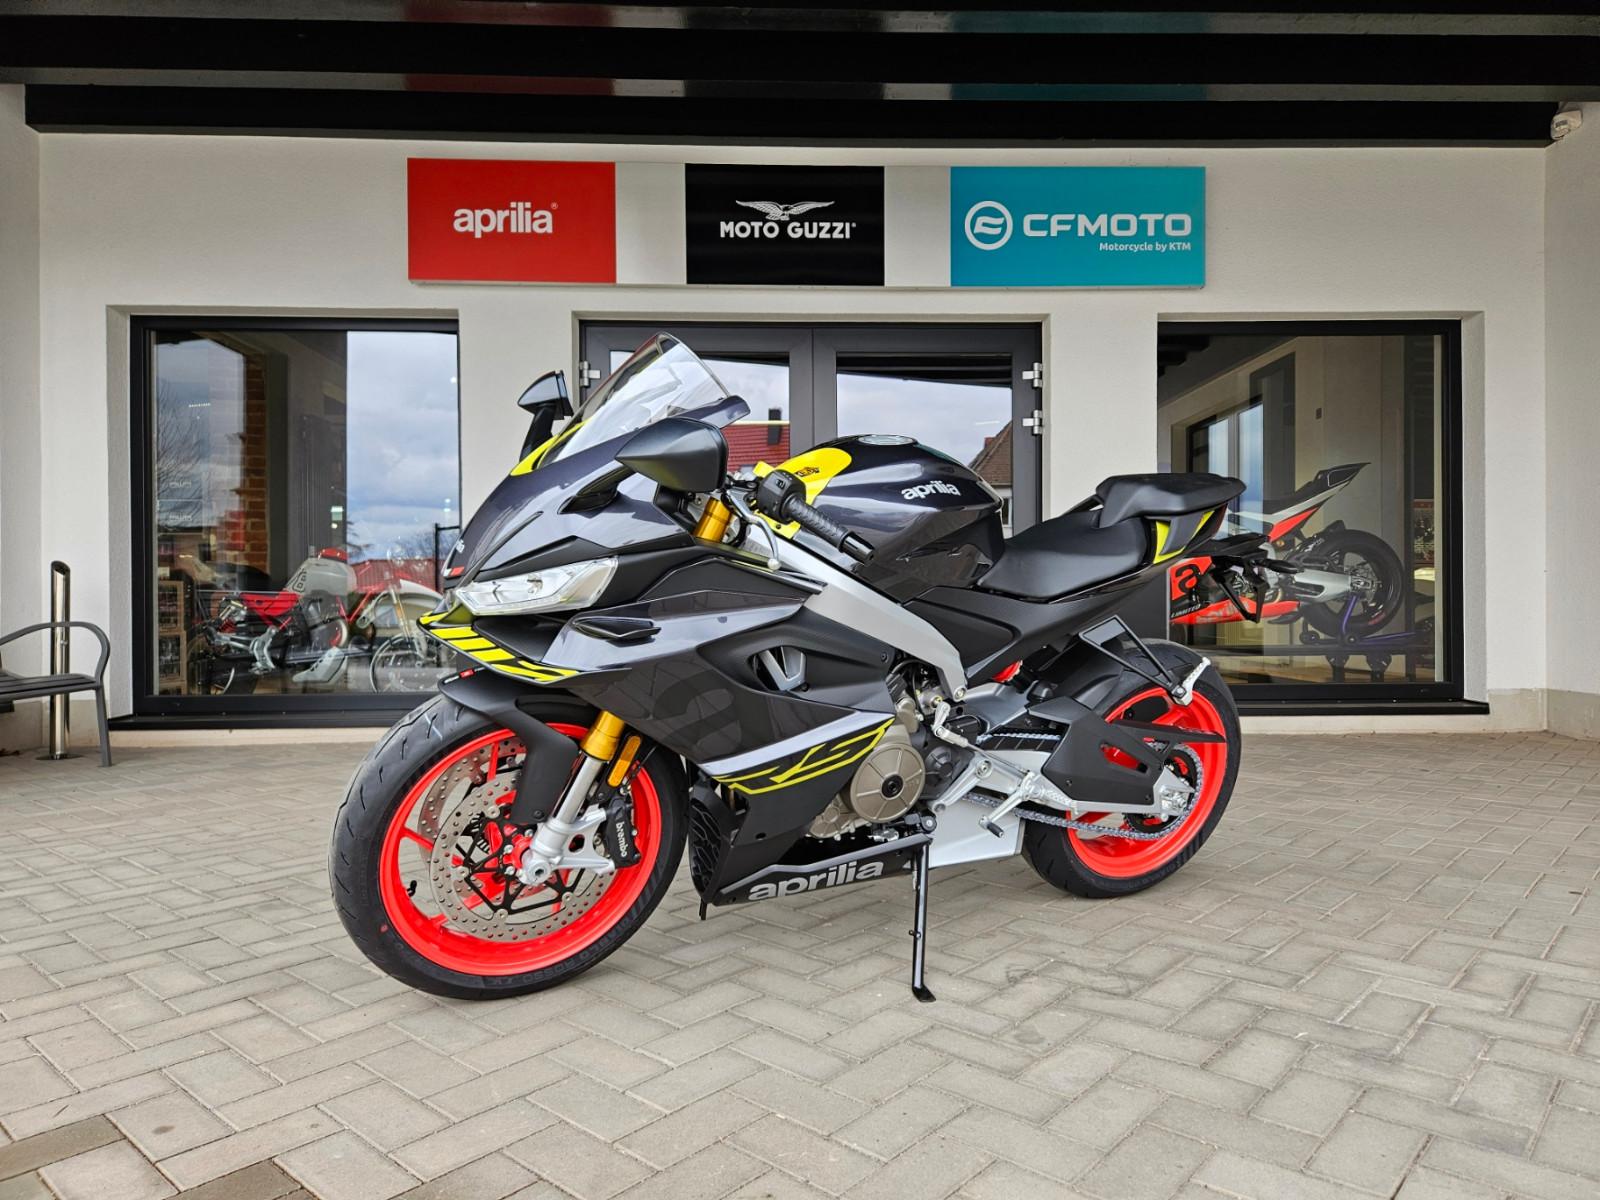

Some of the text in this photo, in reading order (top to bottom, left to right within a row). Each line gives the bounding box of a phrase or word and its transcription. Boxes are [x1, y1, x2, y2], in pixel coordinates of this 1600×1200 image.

[453, 201, 553, 238] aprilia
[720, 221, 850, 239] MOTO GUZZI
[1022, 213, 1192, 237] CFMOTO
[1099, 241, 1191, 252] Motorcycle by KTM
[901, 480, 961, 500] aprilia
[616, 821, 628, 857] brembo
[748, 860, 884, 900] aprilia
